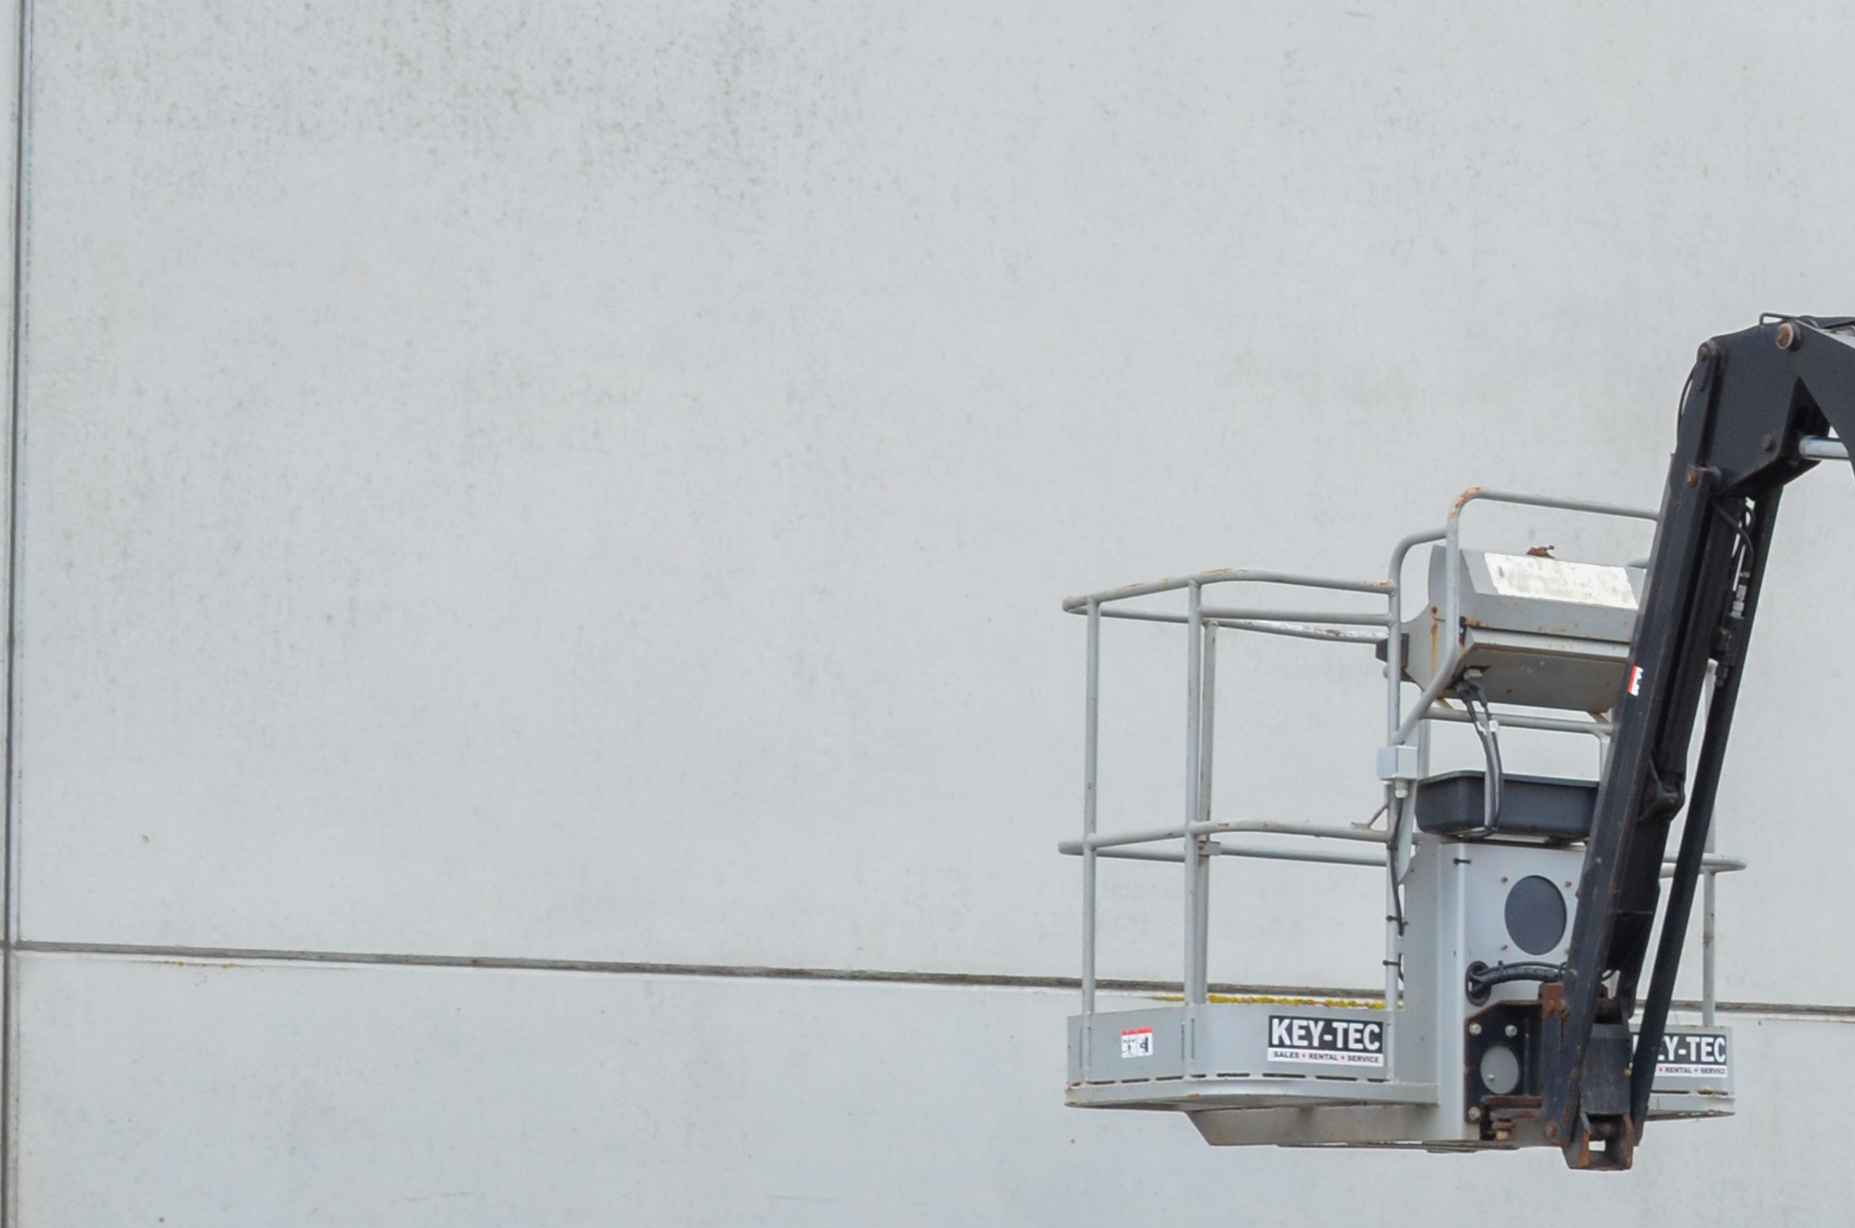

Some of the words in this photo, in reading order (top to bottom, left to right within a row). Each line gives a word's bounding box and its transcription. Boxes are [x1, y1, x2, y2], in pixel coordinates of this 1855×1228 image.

[1271, 1018, 1381, 1051] KEY-TEC
[1273, 1051, 1300, 1059] SALES
[1308, 1053, 1338, 1061] RENTAL
[1347, 1055, 1380, 1064] SERVICE
[1632, 1035, 1726, 1063] Y-TEC
